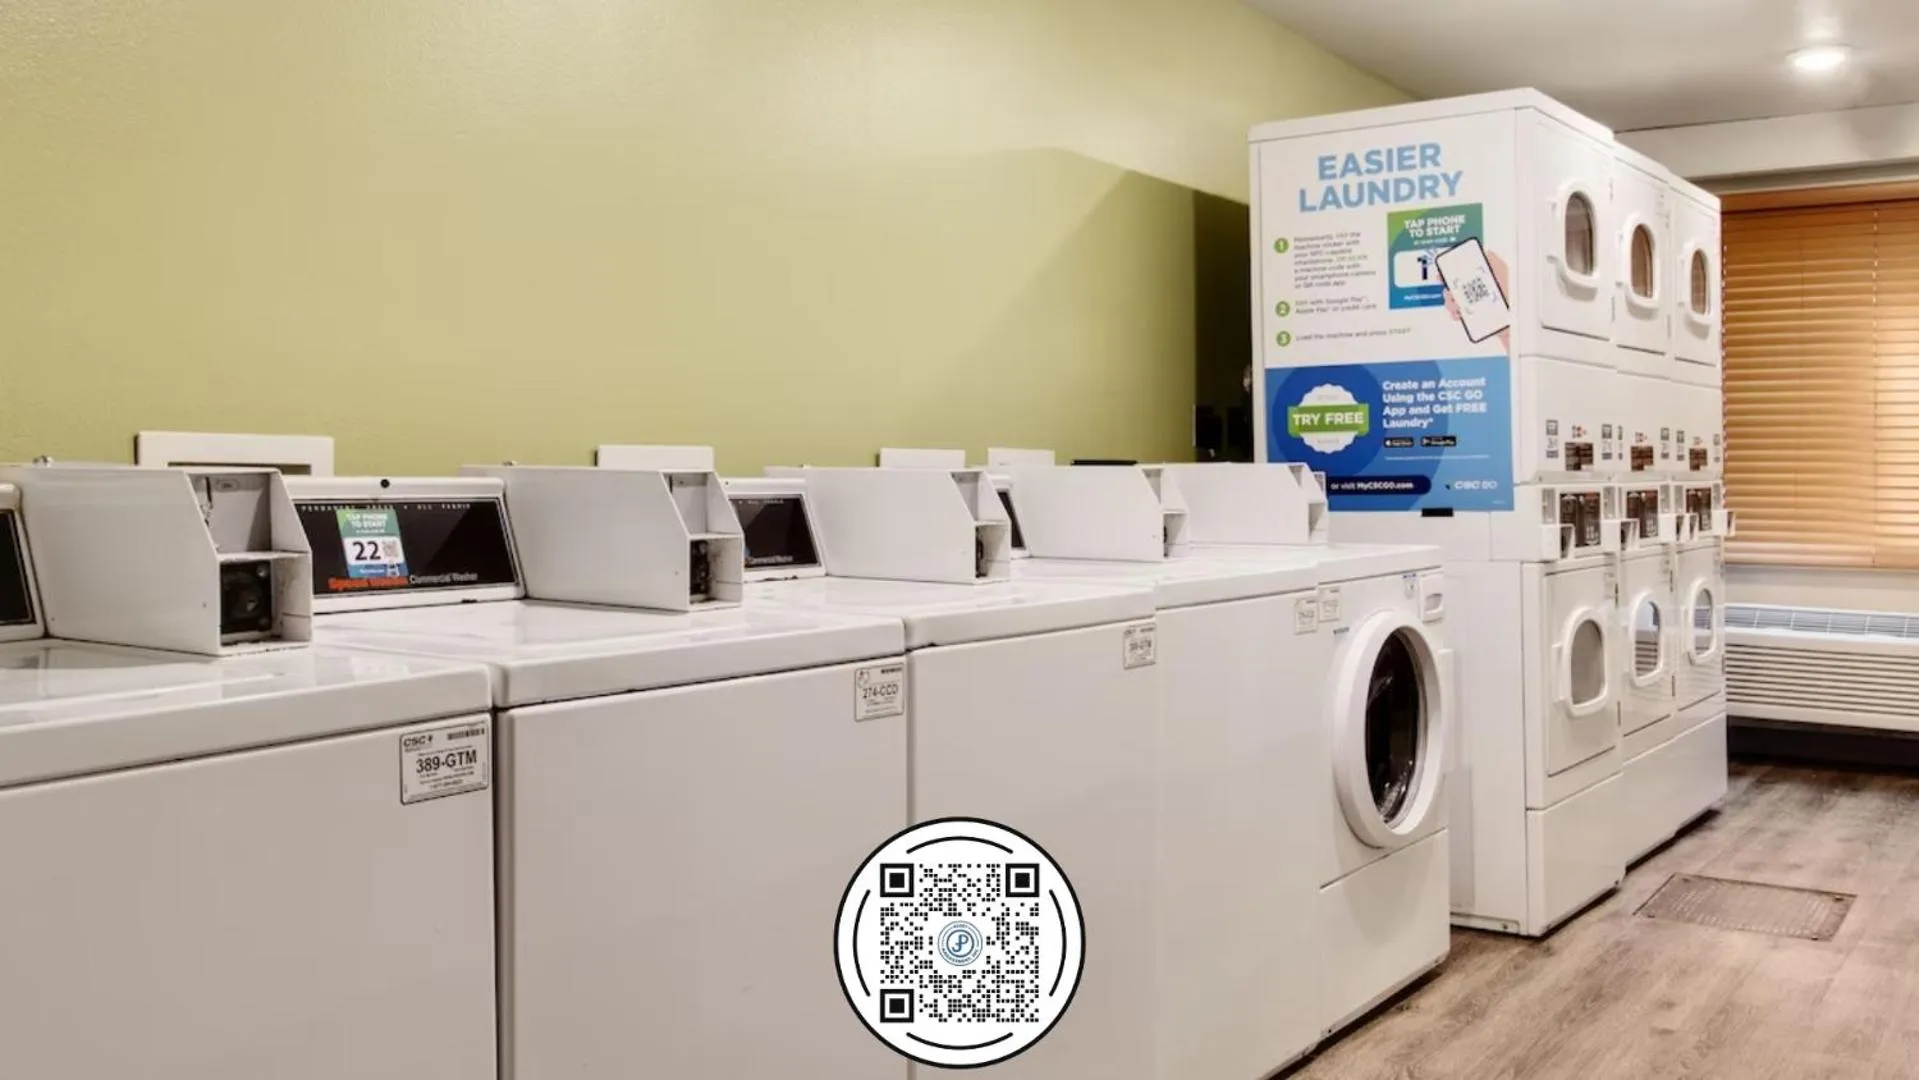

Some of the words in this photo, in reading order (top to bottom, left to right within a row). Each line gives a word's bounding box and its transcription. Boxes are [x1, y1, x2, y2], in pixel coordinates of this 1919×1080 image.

[1317, 142, 1442, 181] EASIER
[1299, 170, 1464, 213] LAUNDRY
[1404, 218, 1425, 229] TAP
[1427, 214, 1465, 227] PHONE
[1409, 228, 1424, 238] TO
[1426, 224, 1461, 236] START
[1417, 255, 1428, 280] 1
[1382, 380, 1418, 391] Create
[1421, 380, 1436, 389] an
[1438, 376, 1486, 388] Account
[1382, 392, 1414, 403] Using
[1416, 391, 1435, 401] the
[1438, 390, 1461, 400] CSC
[1463, 389, 1483, 399] GO
[1382, 406, 1406, 417] App
[1408, 404, 1430, 414] and
[1432, 403, 1453, 414] Get
[1456, 402, 1487, 413] FREE
[1292, 413, 1322, 427] TRY
[1324, 411, 1364, 426] FREE
[1331, 482, 1340, 490] or
[1341, 481, 1356, 490] visit
[352, 541, 382, 561] 22
[410, 572, 450, 584] Commercial
[451, 571, 478, 582] Washer
[415, 749, 477, 774] 389-GTM
